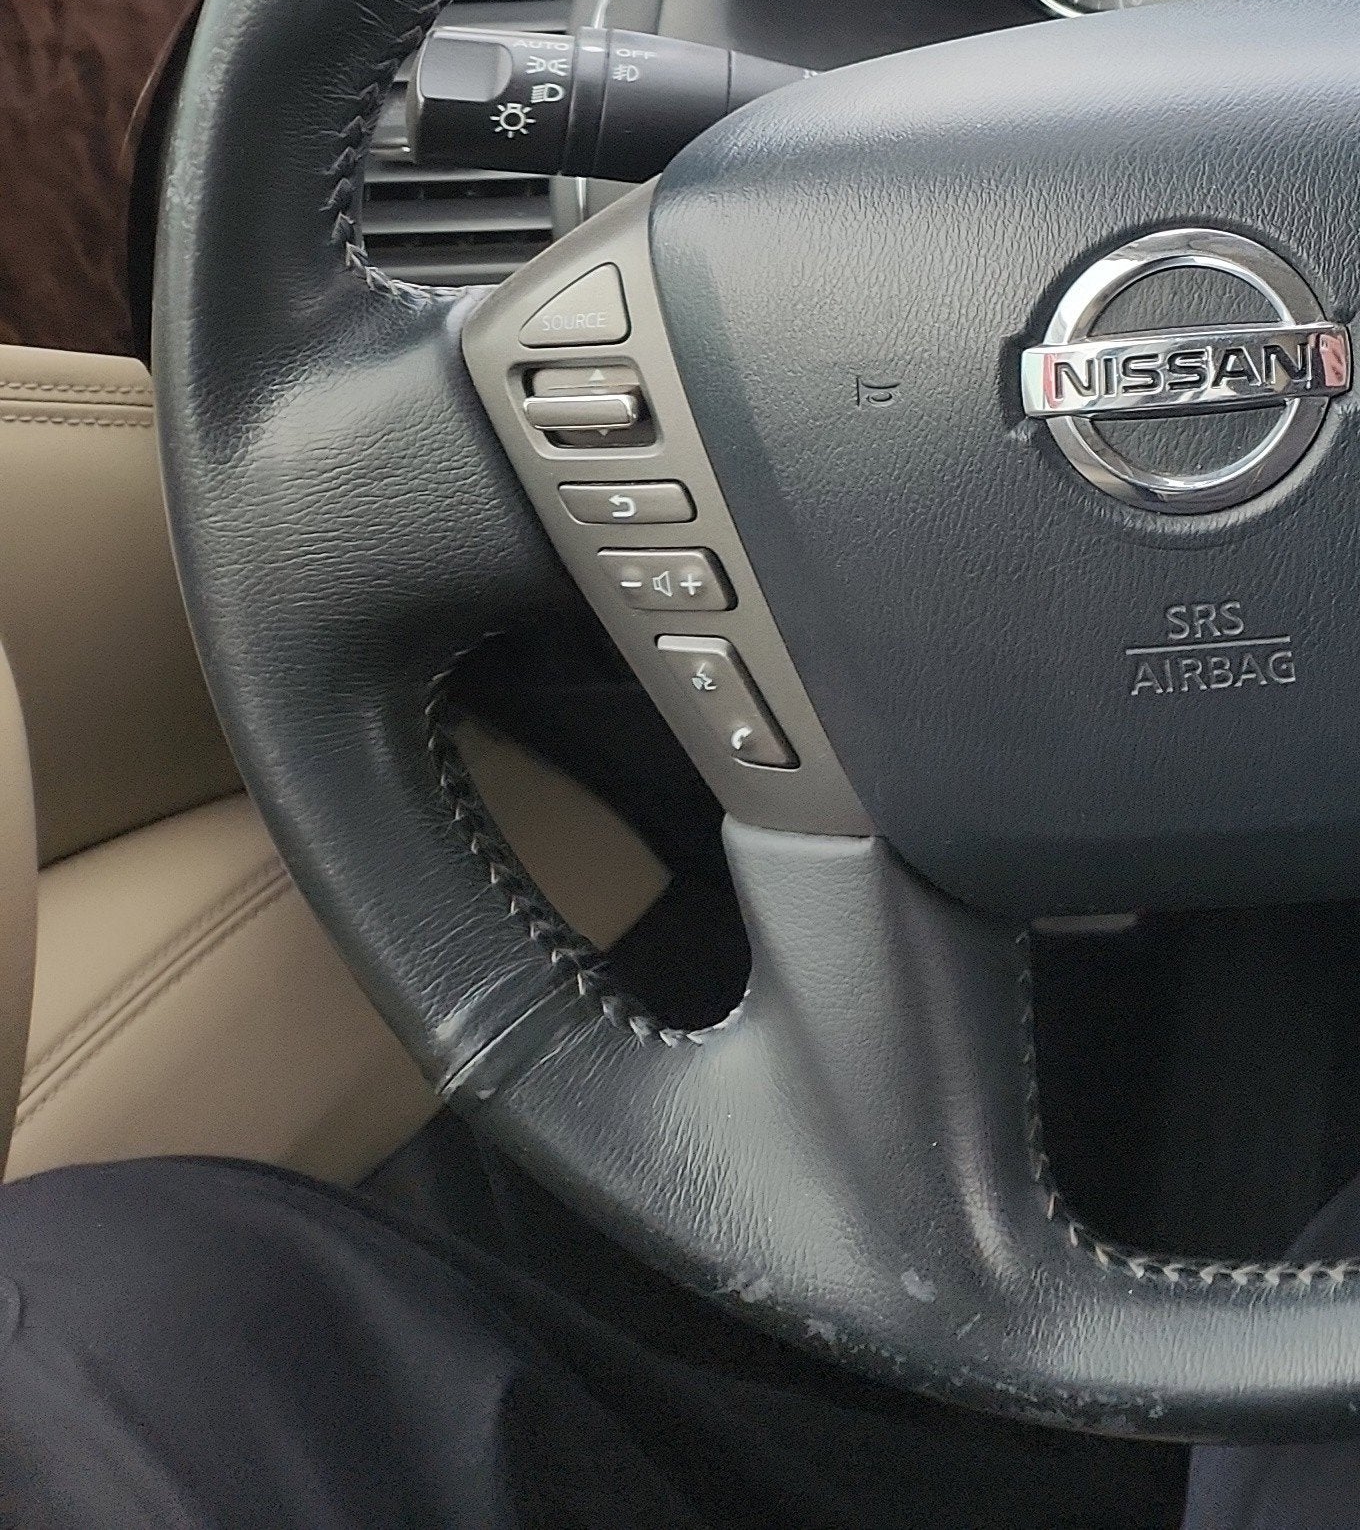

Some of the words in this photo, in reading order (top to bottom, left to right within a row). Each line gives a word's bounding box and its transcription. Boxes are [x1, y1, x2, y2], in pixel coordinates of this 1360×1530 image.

[512, 38, 572, 51] AUTO
[616, 48, 657, 60] OFF
[542, 312, 607, 331] SOURCE
[1053, 342, 1312, 401] NISSAN
[1165, 600, 1245, 641] SRS
[1130, 650, 1296, 696] AIRBAG
